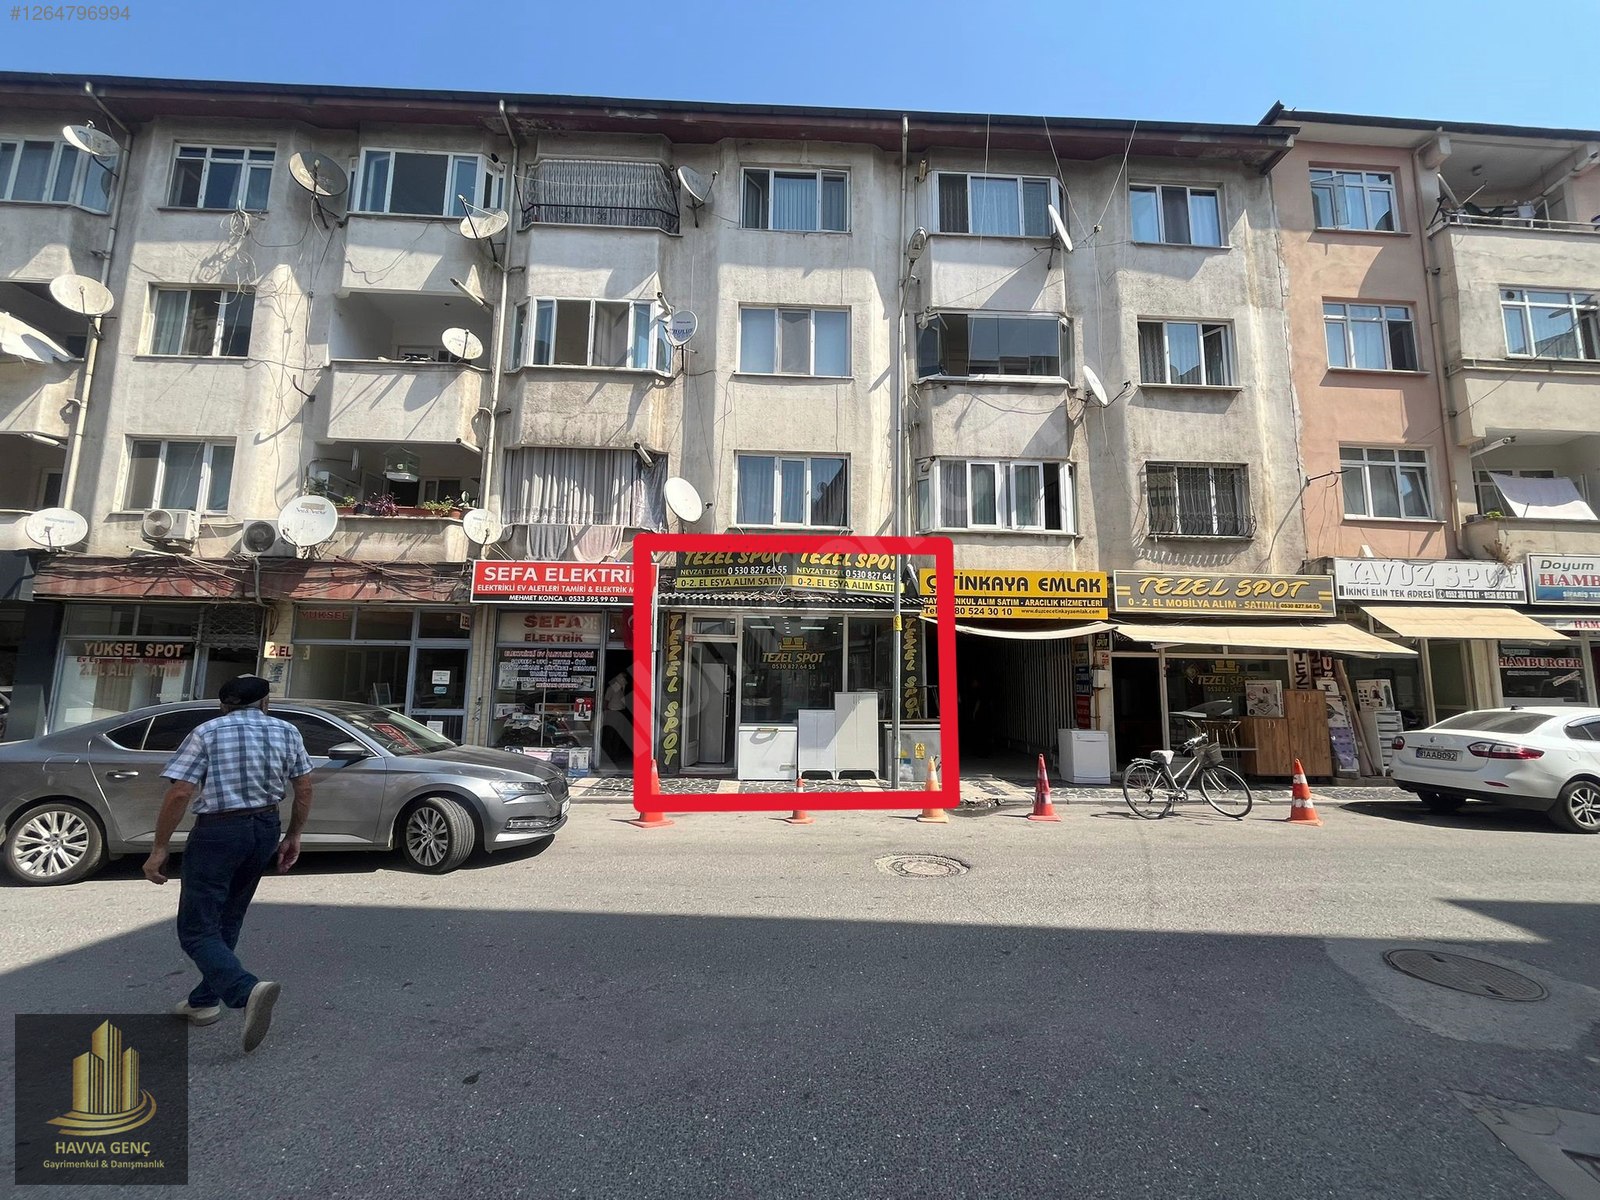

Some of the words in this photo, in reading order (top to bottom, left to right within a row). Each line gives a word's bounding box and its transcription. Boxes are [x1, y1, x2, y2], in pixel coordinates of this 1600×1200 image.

[684, 552, 734, 566] TEZEL
[737, 552, 783, 564] SPOT
[734, 566, 749, 574] 530
[750, 566, 764, 574] 827
[778, 565, 788, 574] 55
[1540, 560, 1594, 571] Doyum
[484, 567, 538, 581] SEFA
[797, 567, 825, 575] NEVZAT
[852, 570, 866, 578] 530
[867, 571, 881, 580] 827
[882, 572, 892, 580] 64
[1348, 563, 1435, 586] YAVUZ
[699, 579, 708, 587] EL
[733, 577, 756, 586] ALIM
[817, 578, 827, 587] EL
[851, 580, 873, 590] ALIM
[875, 583, 895, 592] SATI
[926, 572, 1029, 594] ÇİNKAYA
[1038, 577, 1101, 593] EMLAK
[1138, 576, 1230, 597] TEZEL
[1234, 579, 1310, 598] SPOT
[477, 583, 515, 592] ELEKTRİKLİ
[517, 584, 527, 592] EV
[528, 584, 560, 592] ALETLERİ
[562, 584, 586, 593] TAMİRİ
[595, 585, 627, 593] ELEKTRİK
[1371, 587, 1388, 597] ELİN
[1390, 589, 1405, 598] TEK
[1407, 588, 1435, 598] ADRESİ
[924, 597, 976, 605] GAYNKUL
[997, 598, 1020, 606] SATIM
[1025, 598, 1059, 606] ARACILIK
[1060, 598, 1103, 607] HİZMETLERİ
[1153, 598, 1164, 607] EL
[1166, 597, 1210, 608] MOBİLYA
[1212, 599, 1237, 608] ALIM
[968, 607, 985, 615] 524
[1001, 608, 1013, 616] 10
[523, 614, 582, 628] SEFA
[524, 632, 584, 642] ELEKTRİK
[84, 640, 141, 656] YÜKSEL
[144, 643, 184, 657] SPOT
[269, 644, 292, 657] 2.EL
[762, 652, 792, 663] TEZEL
[795, 652, 825, 663] SPOT
[1498, 656, 1584, 668] HAMBURGER
[1197, 675, 1226, 685] TEZEL
